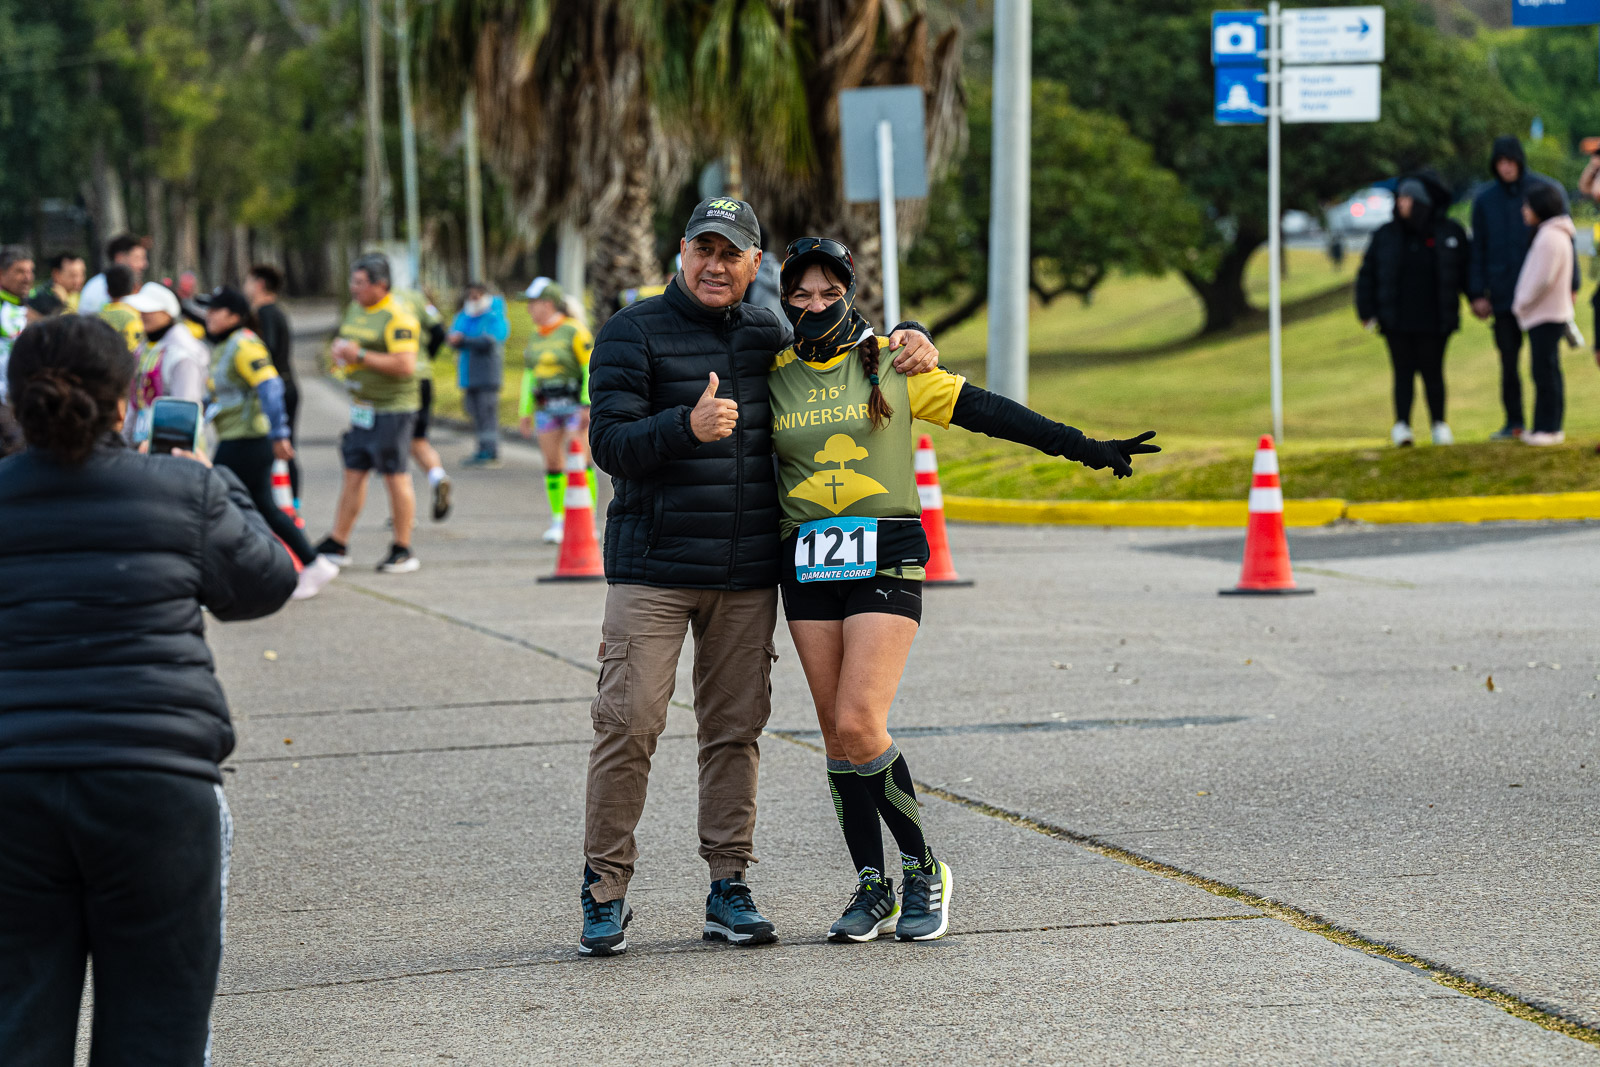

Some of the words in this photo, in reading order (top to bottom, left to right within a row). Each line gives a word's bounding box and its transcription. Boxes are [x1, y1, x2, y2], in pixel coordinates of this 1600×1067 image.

[708, 200, 741, 211] 46
[773, 403, 886, 432] ANIVERSAR
[802, 526, 865, 568] 121
[801, 570, 842, 580] DIAMANTE
[843, 569, 872, 578] CORRE
